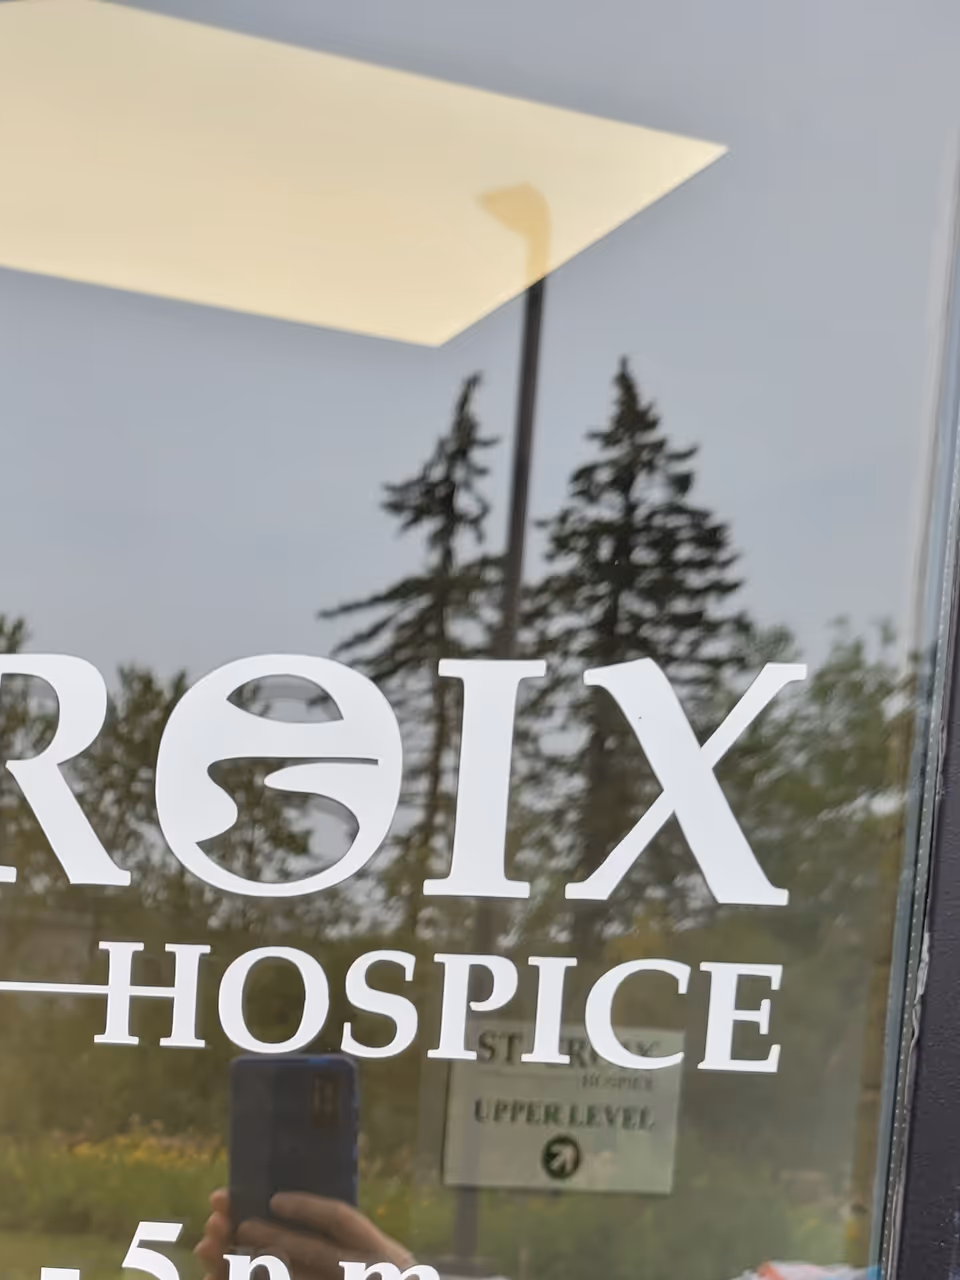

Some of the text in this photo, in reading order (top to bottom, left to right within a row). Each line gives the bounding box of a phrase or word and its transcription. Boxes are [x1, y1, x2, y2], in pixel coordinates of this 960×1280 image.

[93, 940, 783, 1073] HOSPICE
[474, 1098, 655, 1131] UPPER LEVEL
